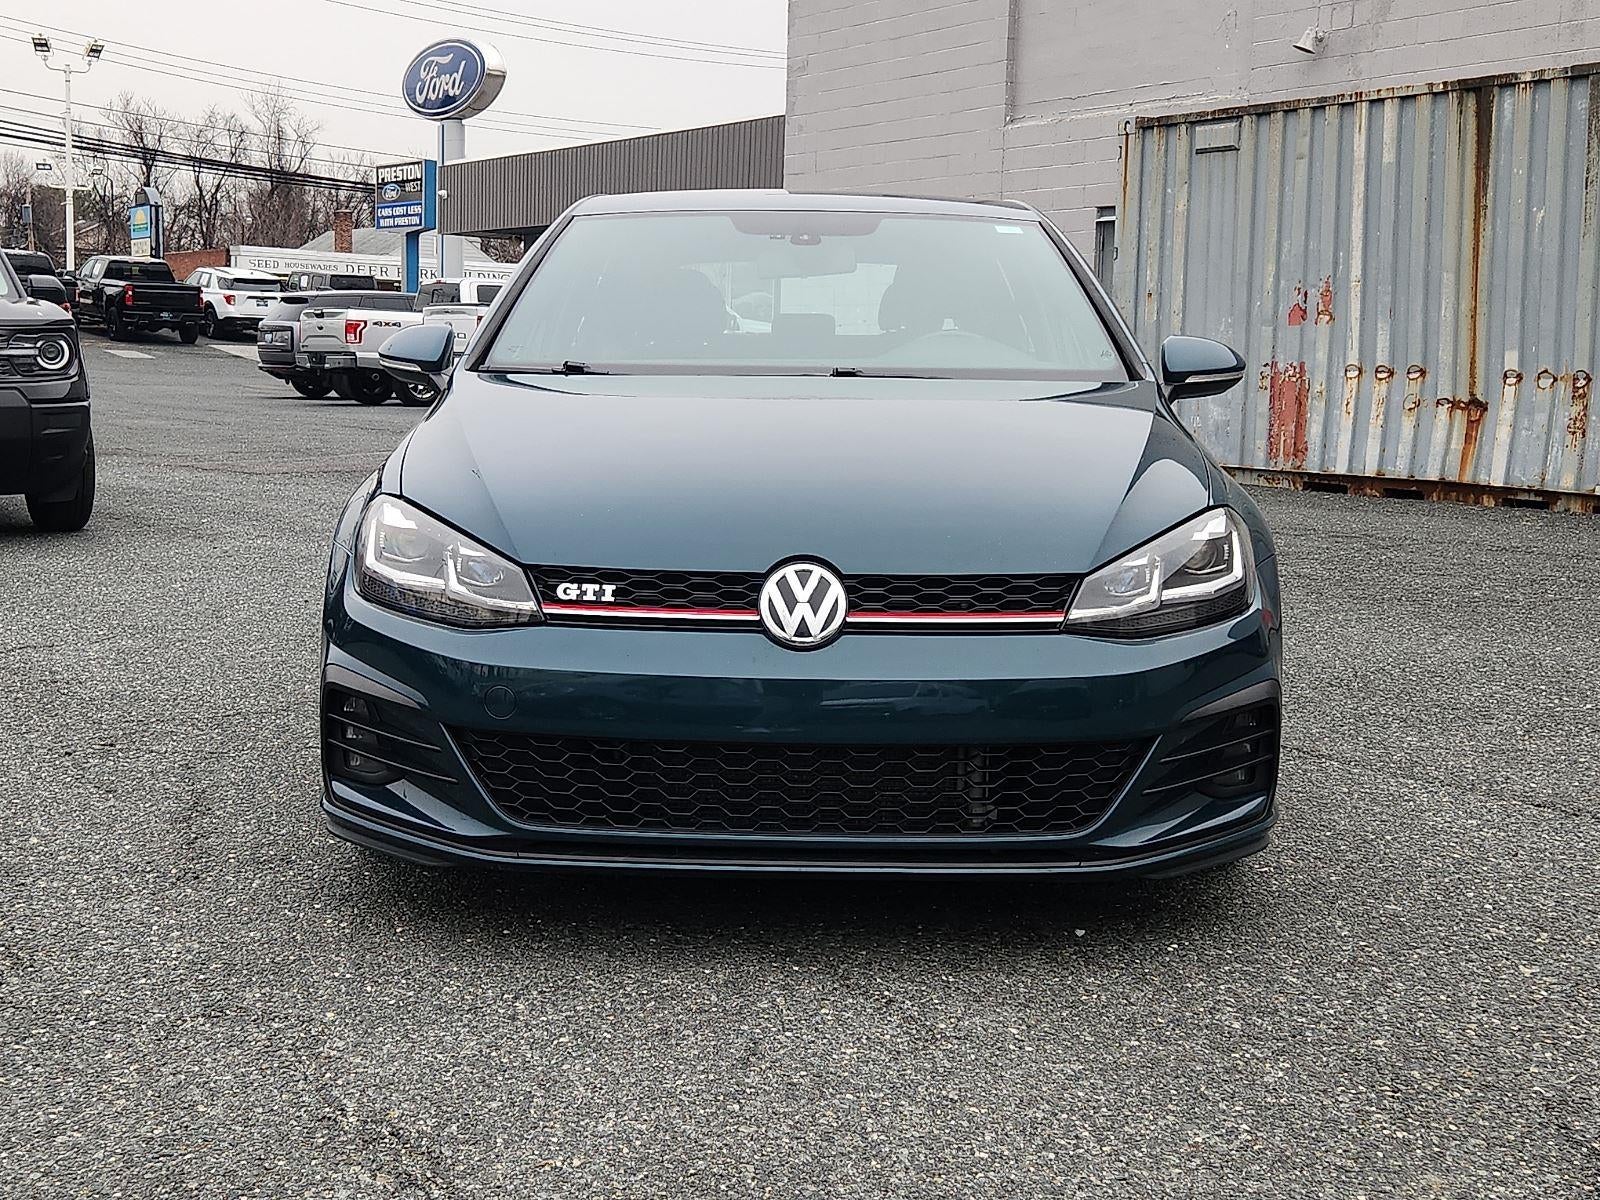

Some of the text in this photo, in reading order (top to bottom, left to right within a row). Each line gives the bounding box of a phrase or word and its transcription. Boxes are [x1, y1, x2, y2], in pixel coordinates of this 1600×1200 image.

[415, 53, 466, 104] Ford
[377, 163, 422, 184] PRESTON
[405, 181, 421, 193] WEST
[393, 205, 407, 216] COST
[408, 204, 422, 215] LESS
[380, 215, 420, 227] WITH PRESTON
[249, 259, 279, 270] SEED
[284, 261, 339, 272] HOUSEWARES
[345, 263, 389, 277] DEER
[397, 267, 438, 279] RK
[556, 582, 617, 602] GTI
[761, 562, 846, 643] VW
